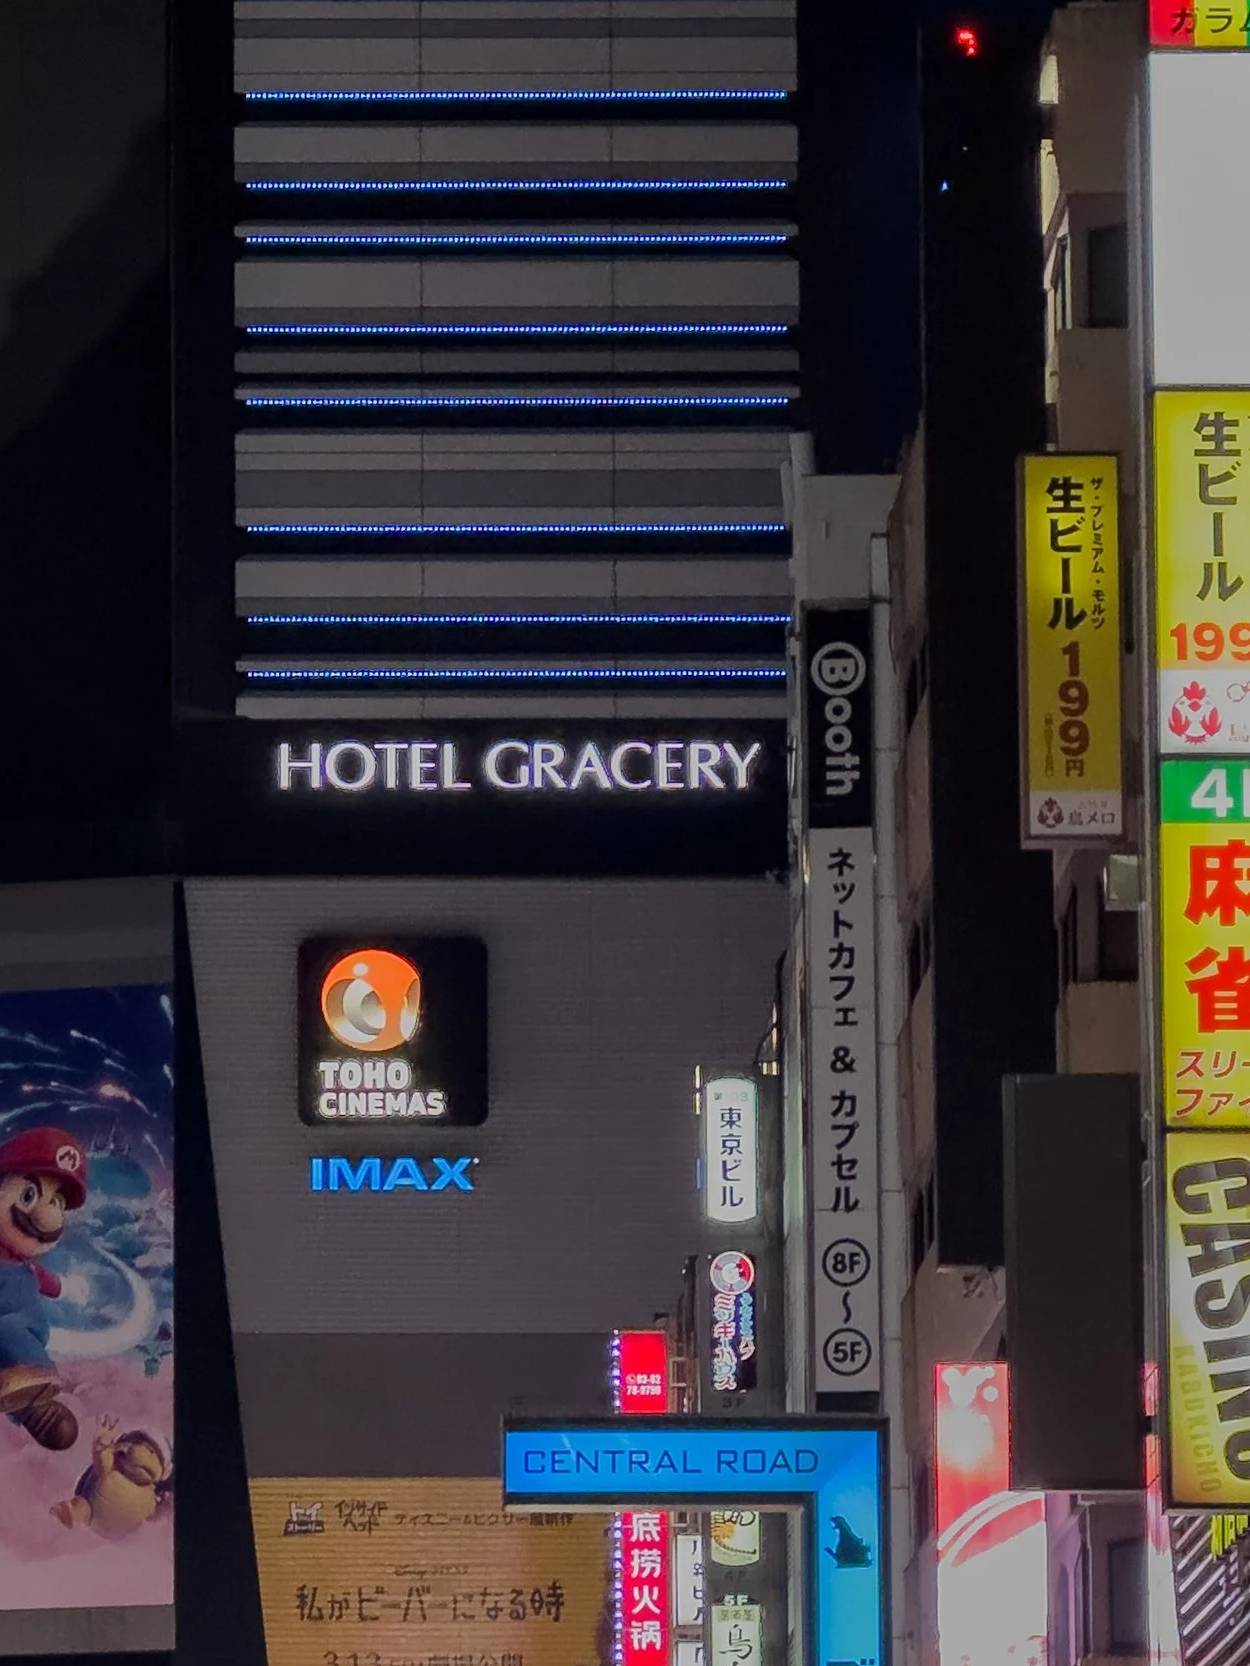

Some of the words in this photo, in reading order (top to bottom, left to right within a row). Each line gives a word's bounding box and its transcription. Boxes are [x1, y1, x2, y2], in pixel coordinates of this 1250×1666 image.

[1194, 411, 1244, 602] 生ビール
[1046, 476, 1087, 631] 生ビール
[1057, 640, 1091, 777] 199円
[277, 741, 472, 791] HOTEL
[484, 741, 761, 791] GRACERY
[317, 1061, 412, 1089] TOHO
[317, 1091, 446, 1118] CINEMAS
[310, 1156, 474, 1191] IMAX
[718, 1107, 744, 1209] 東京ビル
[523, 1451, 703, 1474] CENTRAL
[717, 1450, 818, 1473] ROAD
[295, 1580, 565, 1624] 私がビーバーになる時
